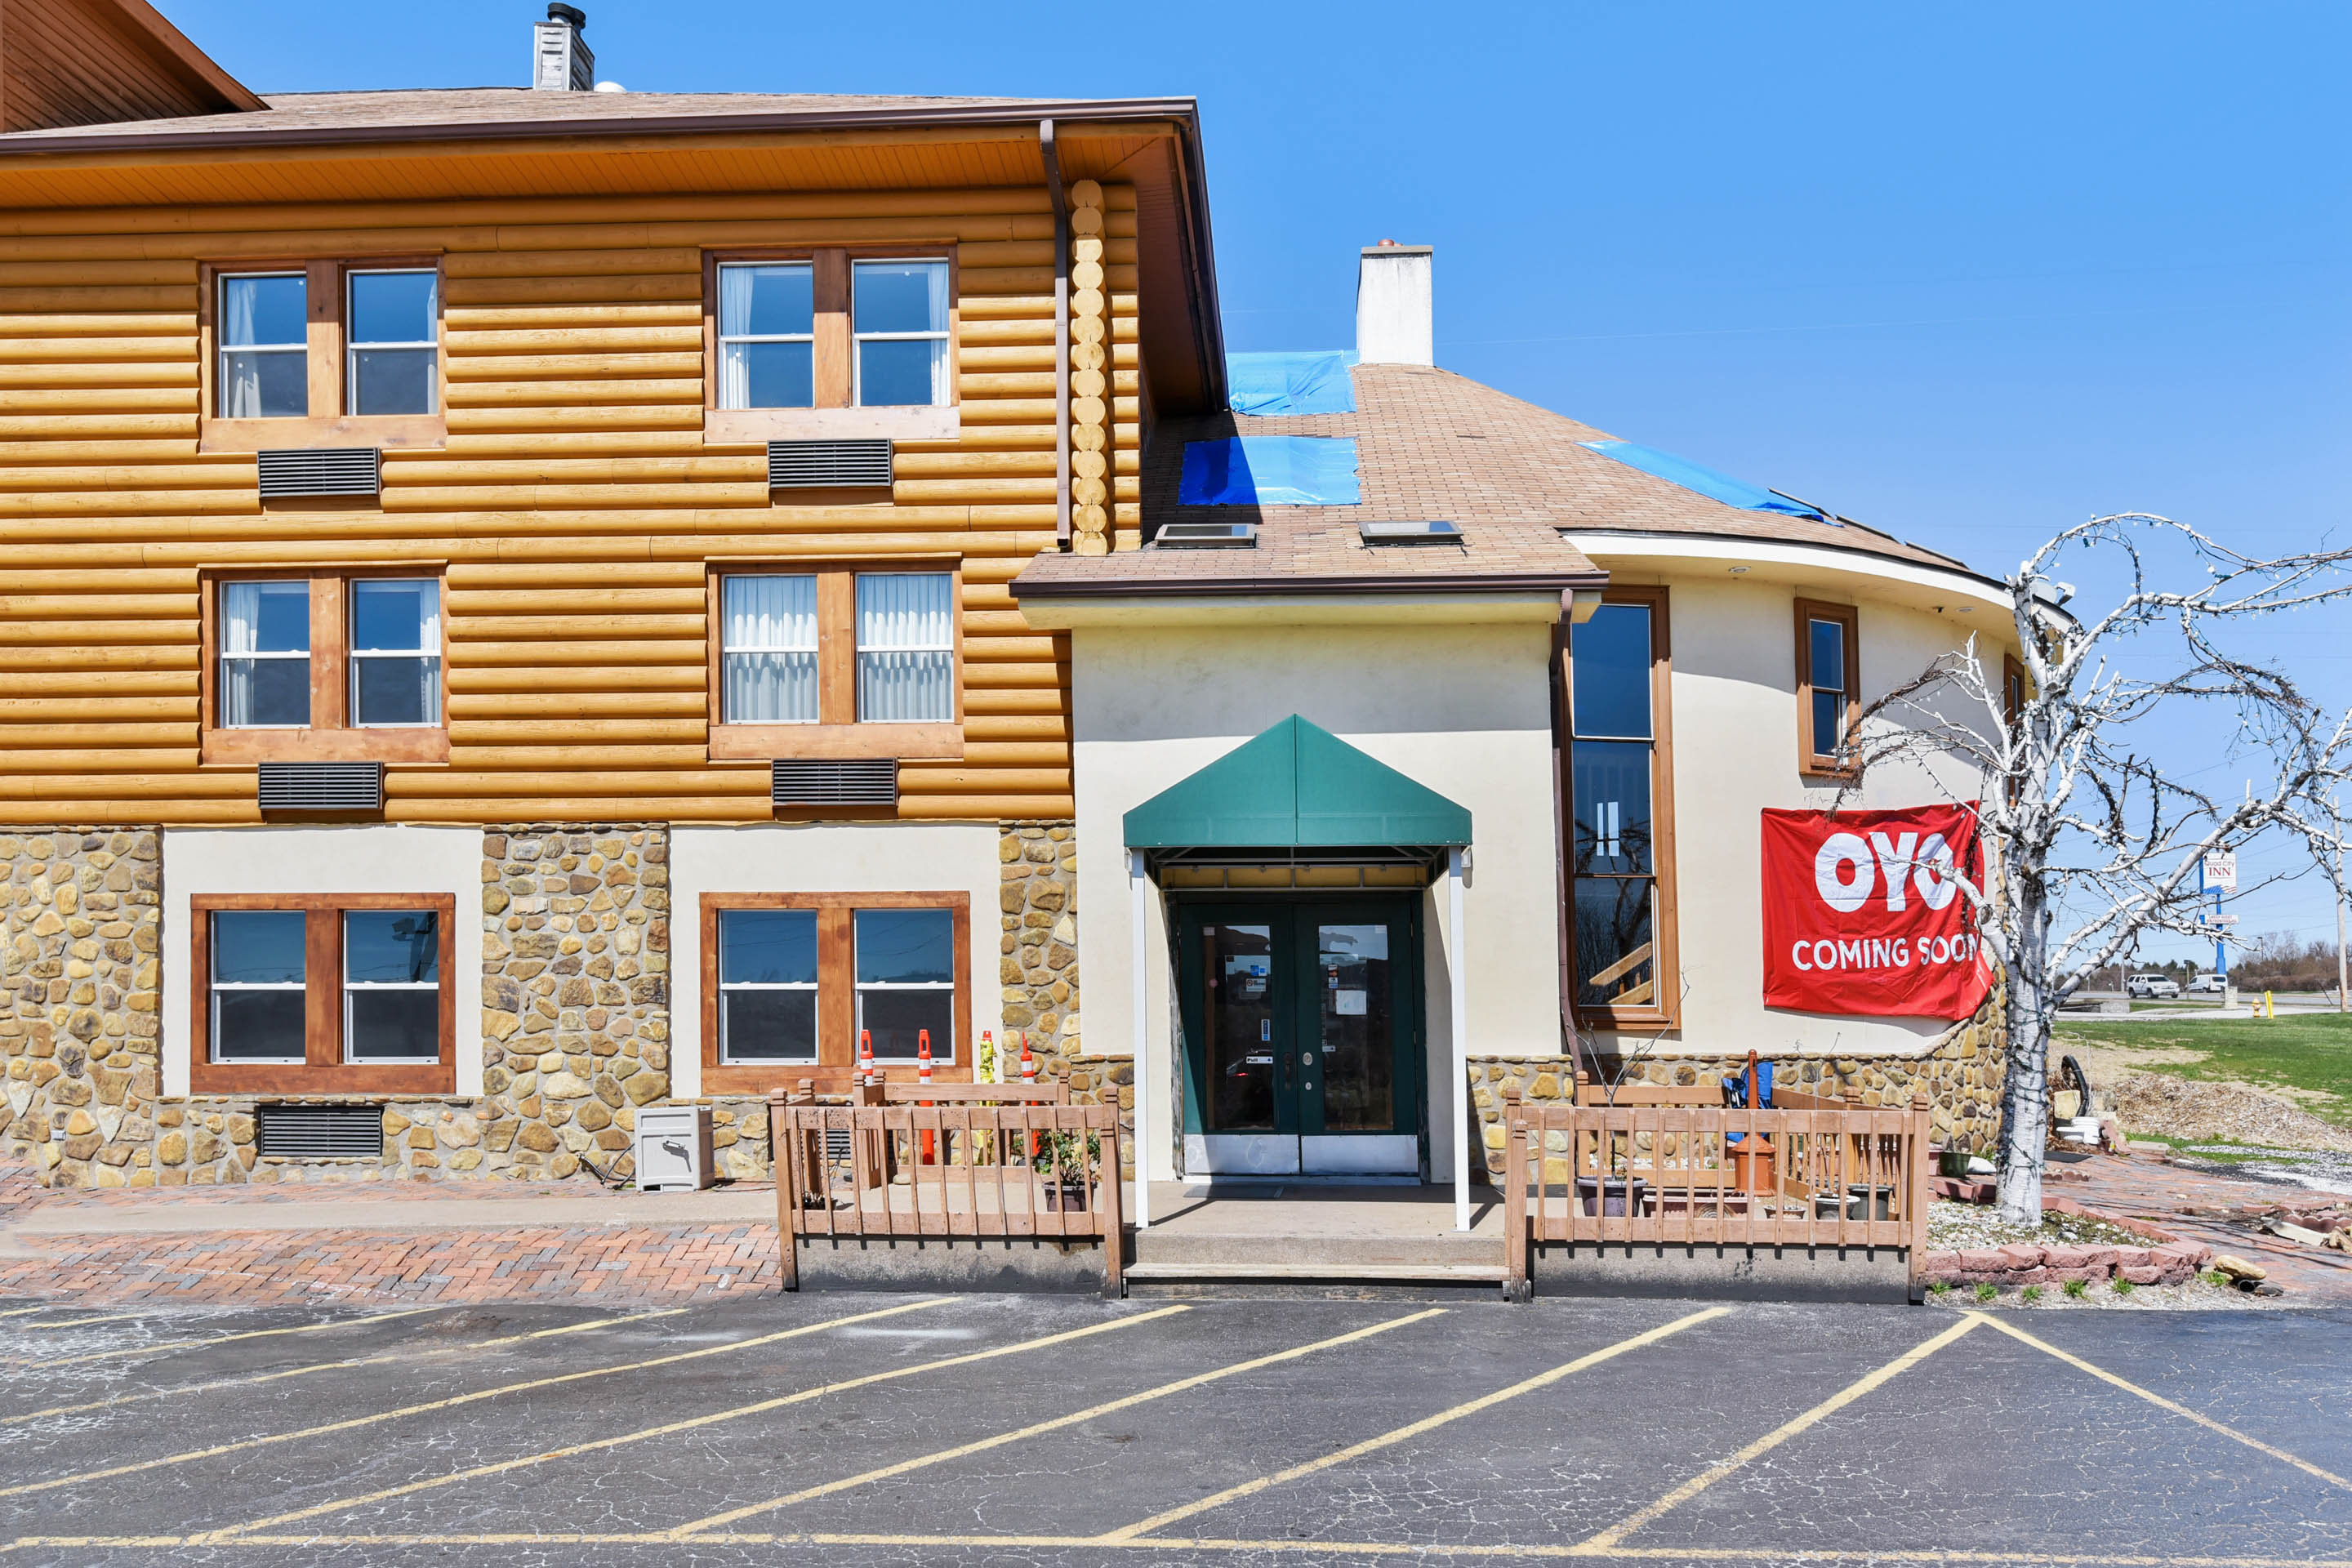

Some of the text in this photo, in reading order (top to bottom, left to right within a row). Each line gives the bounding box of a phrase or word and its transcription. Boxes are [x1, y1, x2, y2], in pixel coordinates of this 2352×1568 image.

[1815, 831, 1958, 913] OYO
[2209, 867, 2230, 876] INN
[1792, 933, 1980, 971] COMING SOON
